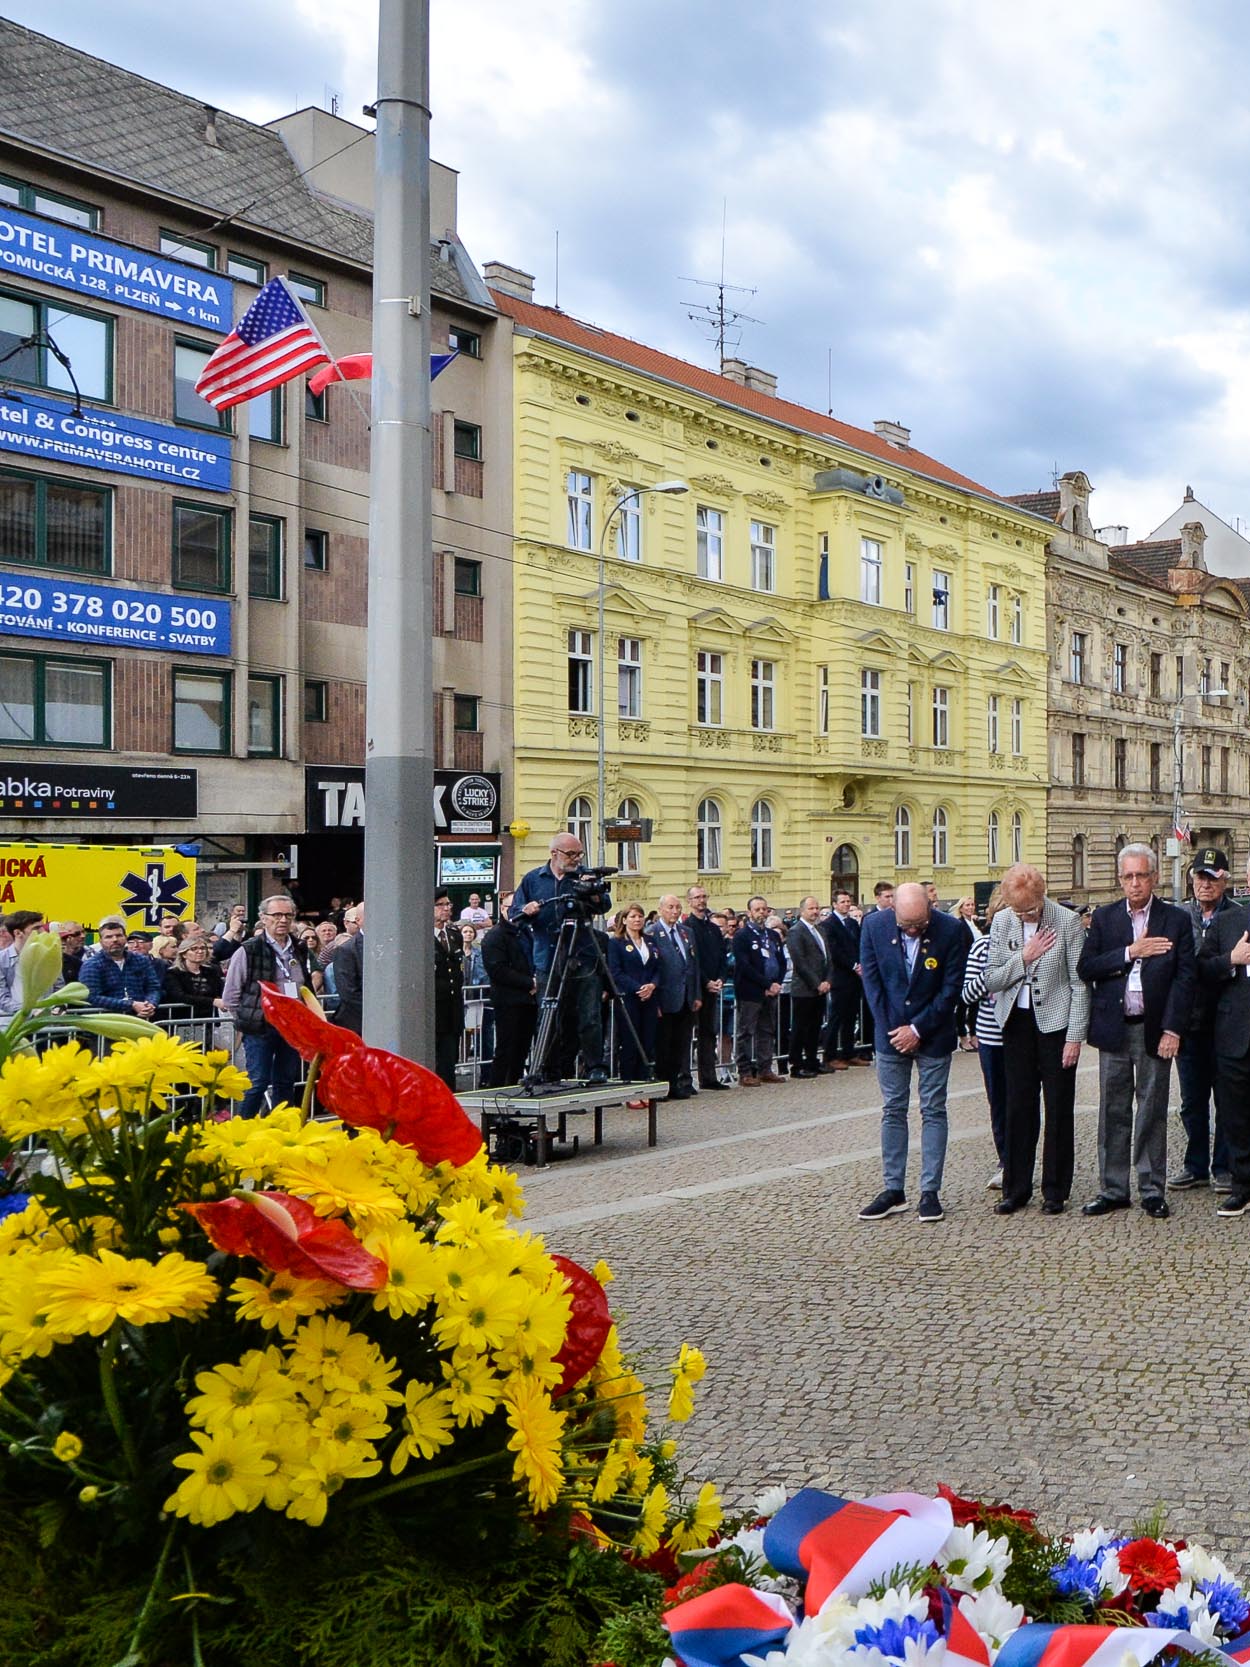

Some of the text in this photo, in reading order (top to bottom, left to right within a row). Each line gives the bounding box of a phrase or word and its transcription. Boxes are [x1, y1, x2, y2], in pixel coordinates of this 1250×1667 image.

[0, 251, 220, 325] OMUCKÁ 128, PLZEŇ 4 km
[71, 243, 220, 306] PRIMAVERA
[35, 413, 55, 430] &
[61, 419, 152, 451] Congress
[158, 443, 217, 464] centre
[0, 584, 217, 629] 20 378 020 500
[67, 622, 156, 641] KONFERENCE
[169, 632, 217, 647] SVATBY
[55, 786, 115, 800] Potraviny
[462, 796, 489, 806] STRIKE
[464, 788, 489, 798] LUCKY
